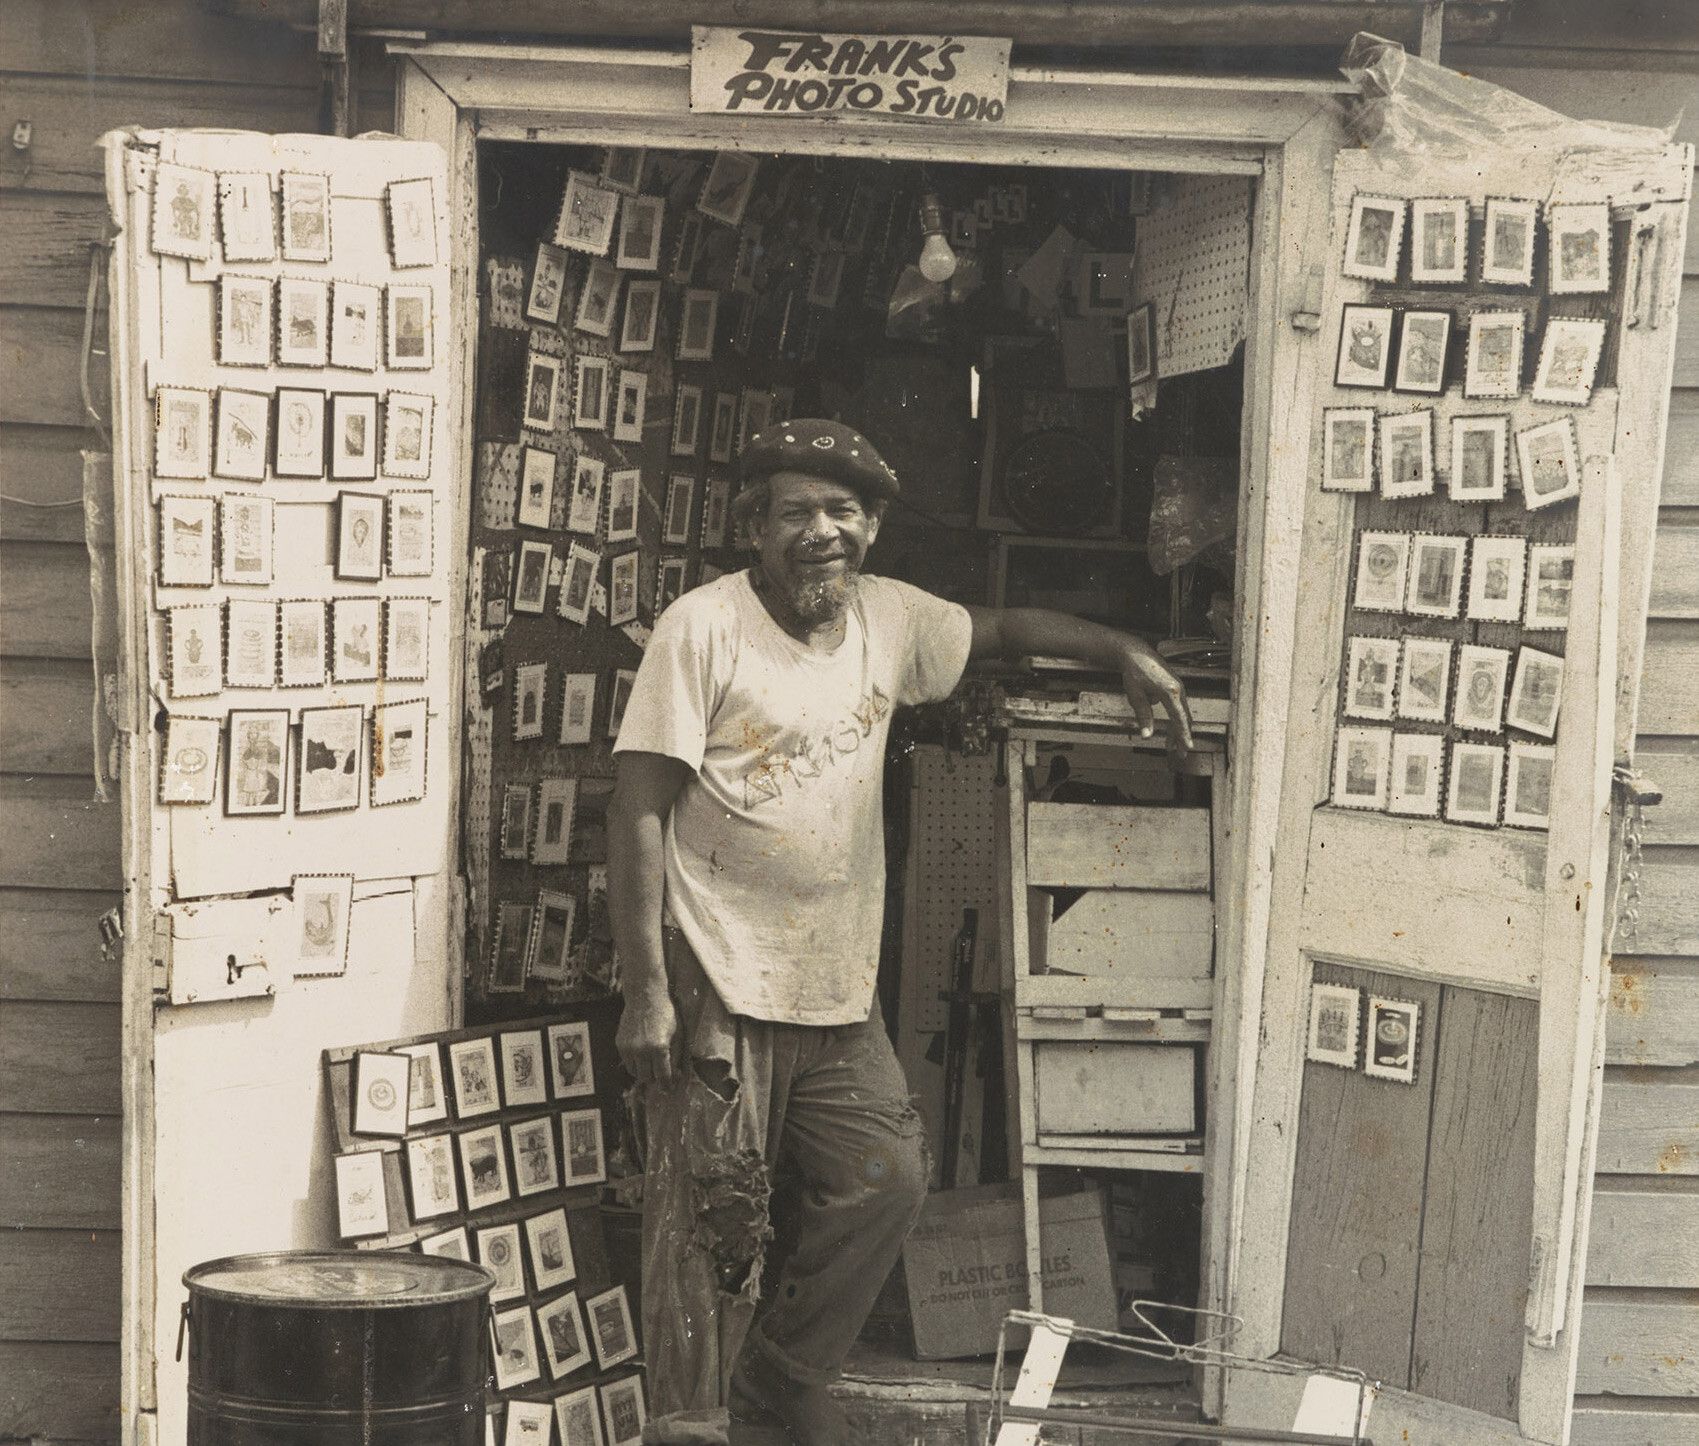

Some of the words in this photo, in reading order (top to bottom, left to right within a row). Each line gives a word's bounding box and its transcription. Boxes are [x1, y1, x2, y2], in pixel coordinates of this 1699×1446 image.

[738, 32, 965, 82] FRANK'S
[724, 71, 883, 111] PHOTO
[889, 79, 1004, 122] STUDIO
[938, 1265, 1003, 1287] PLASTIC
